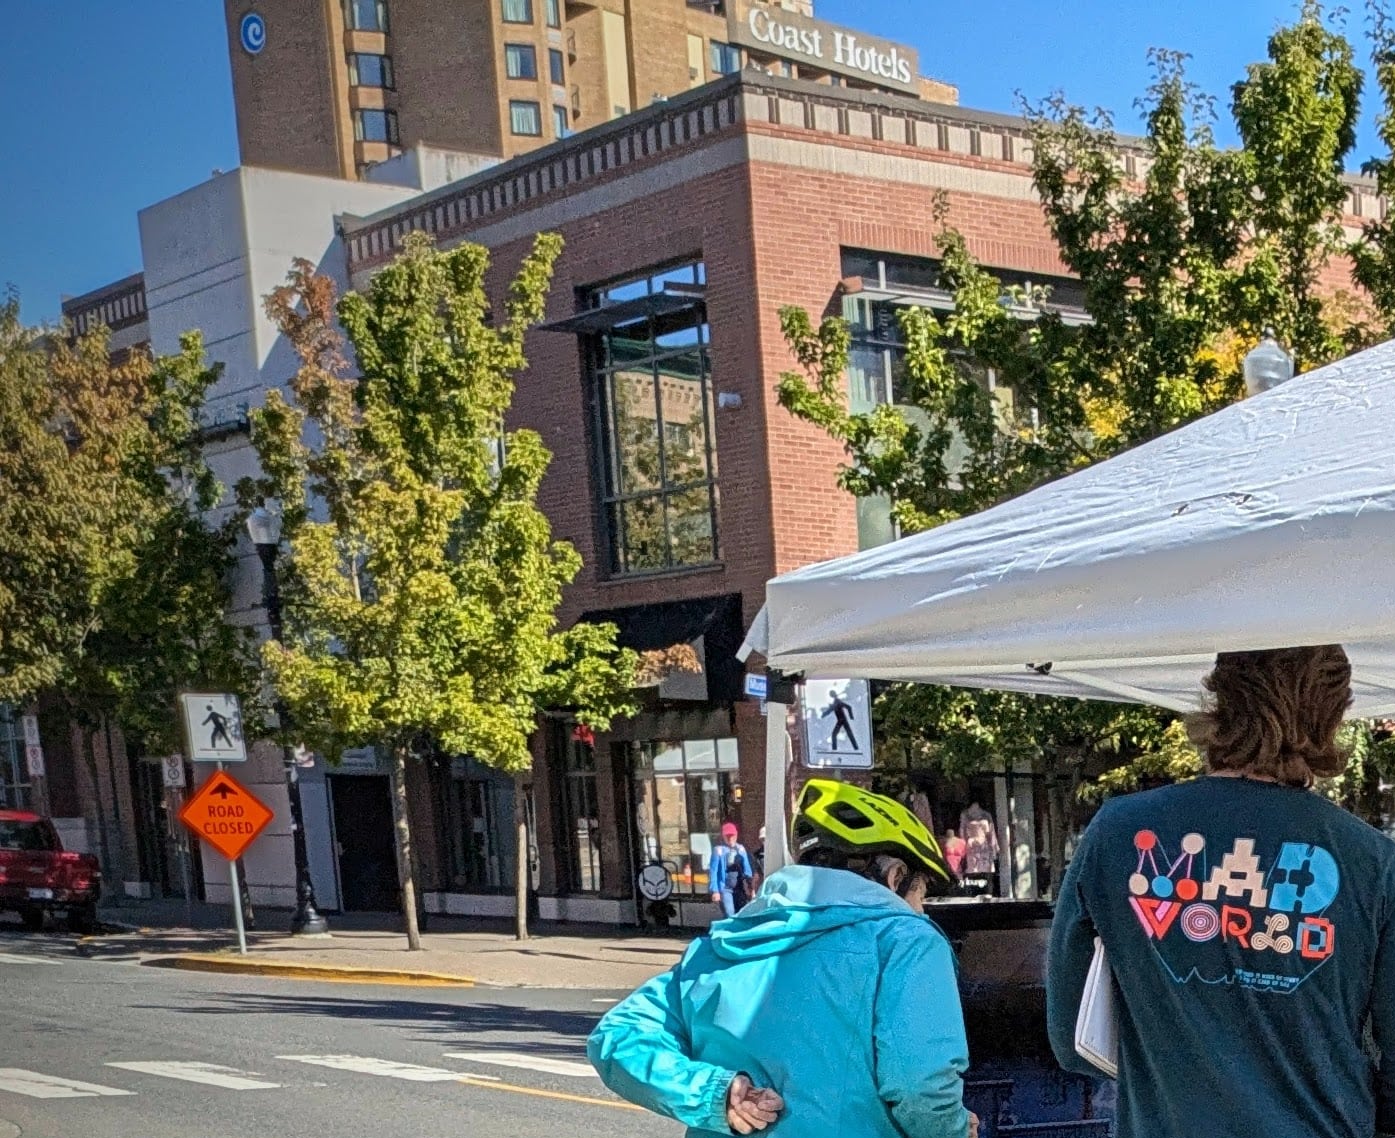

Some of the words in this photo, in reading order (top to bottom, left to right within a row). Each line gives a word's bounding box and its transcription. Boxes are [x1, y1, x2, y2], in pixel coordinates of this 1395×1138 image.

[750, 8, 823, 58] Coast
[832, 31, 911, 84] Hotels
[203, 822, 254, 834] CLOSED
[208, 805, 244, 818] ROAD
[1129, 829, 1340, 914] MAD
[1128, 896, 1335, 960] WORLD
